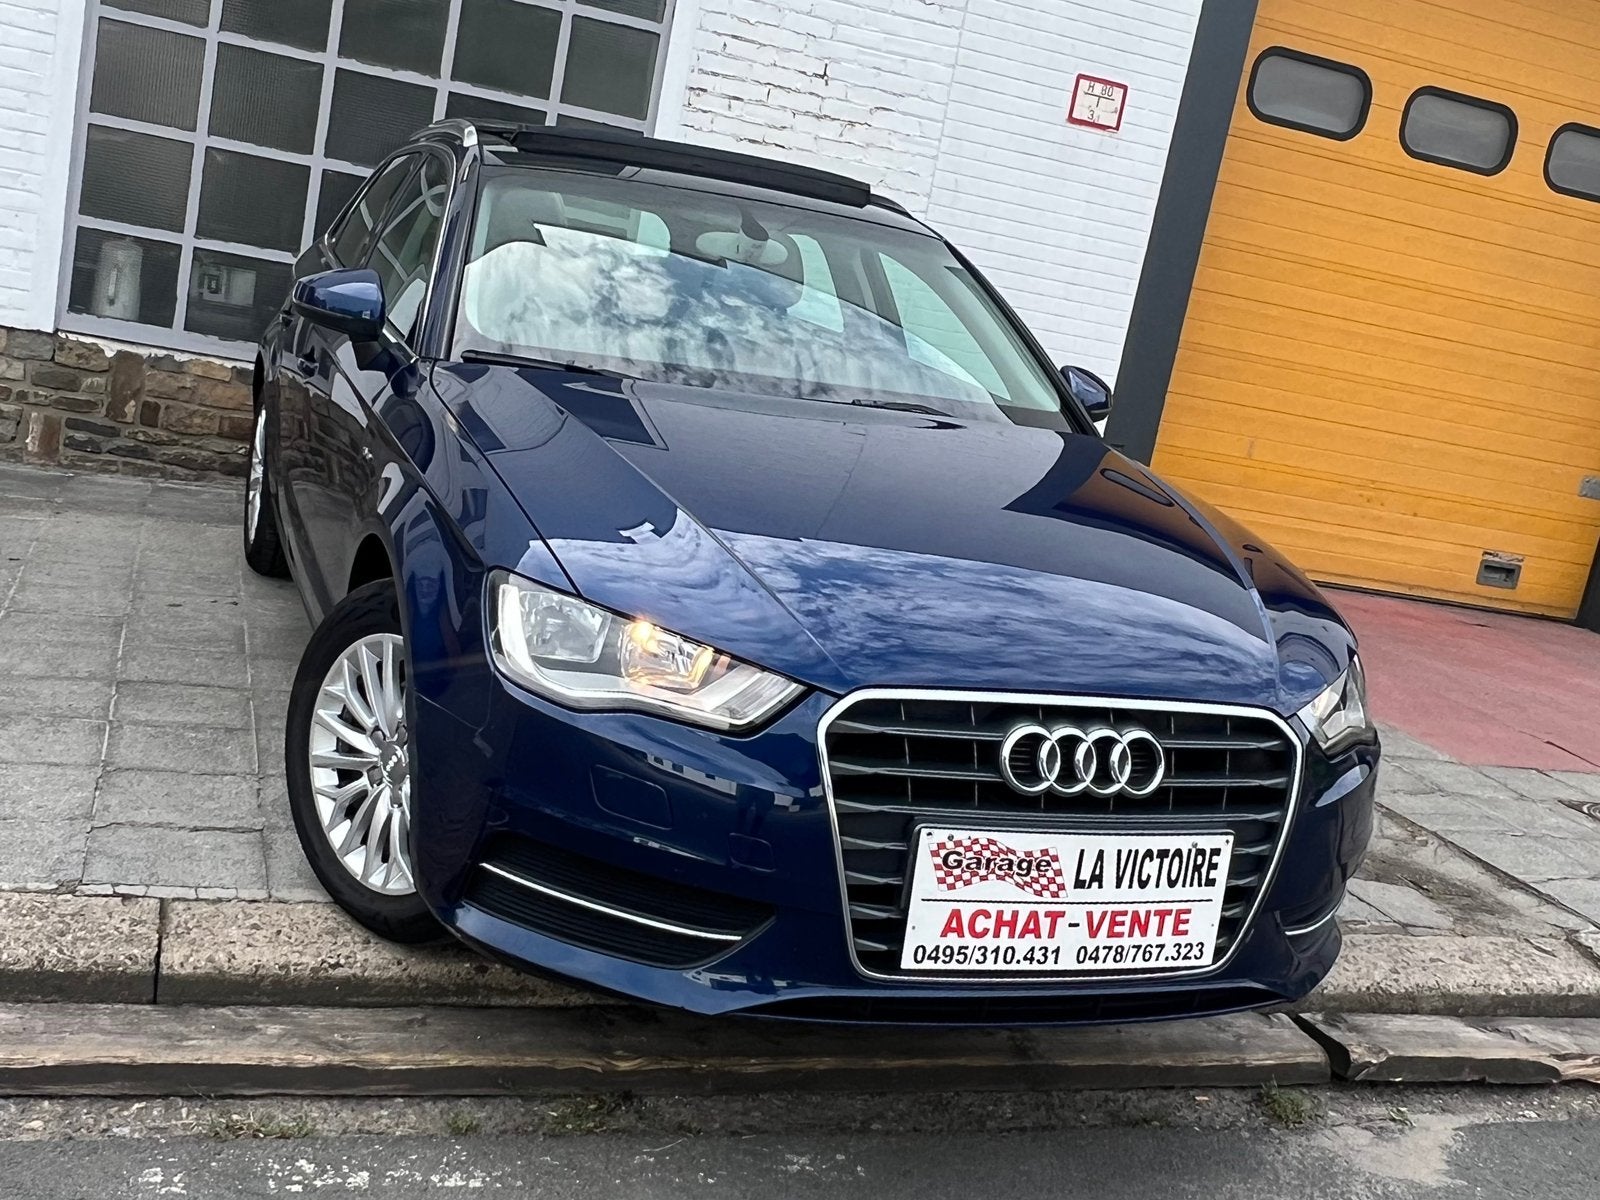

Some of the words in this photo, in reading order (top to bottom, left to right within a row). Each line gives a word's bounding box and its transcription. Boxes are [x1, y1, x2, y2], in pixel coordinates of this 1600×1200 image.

[1087, 82, 1095, 93] H
[1100, 85, 1114, 97] 80
[941, 850, 1052, 878] Garage
[1073, 848, 1104, 890] LA
[1115, 847, 1222, 889] VICTOIRE
[913, 944, 1061, 966] 0495/310.431
[1076, 942, 1205, 965] 0478/767.323
